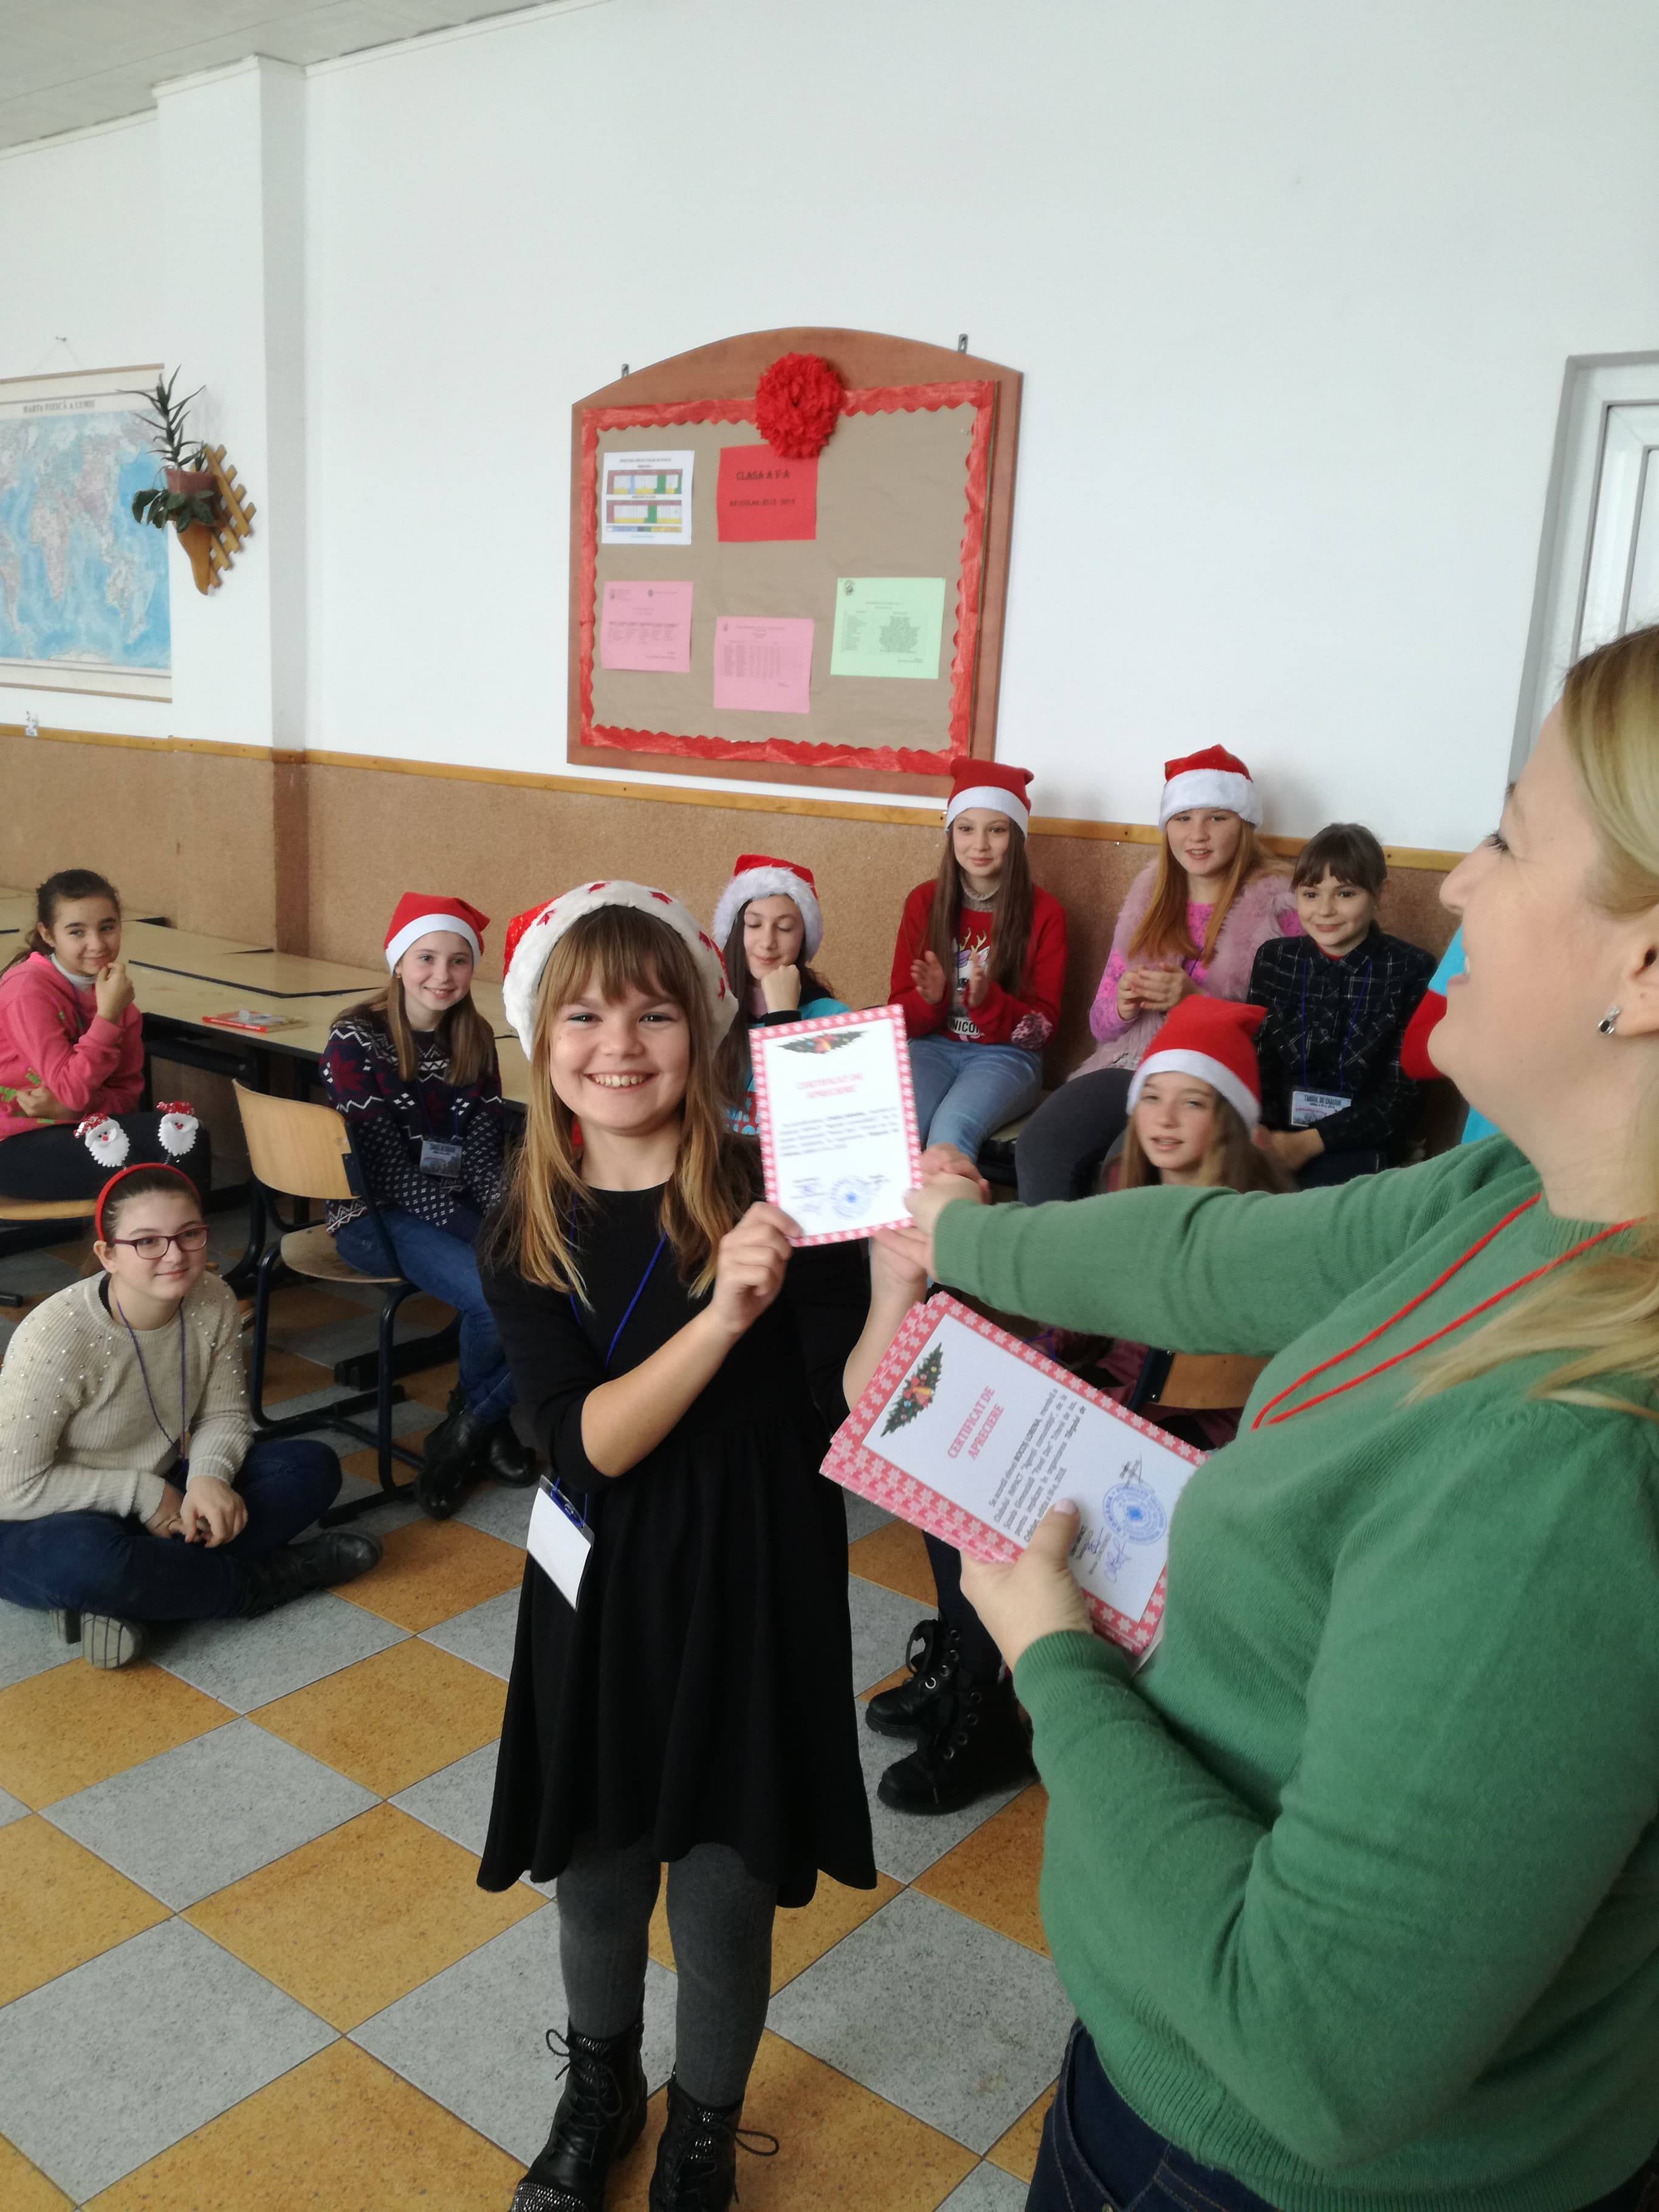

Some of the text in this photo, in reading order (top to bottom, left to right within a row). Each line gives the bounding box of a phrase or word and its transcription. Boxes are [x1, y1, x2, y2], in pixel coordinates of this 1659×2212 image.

[736, 471, 763, 480] CLASA
[946, 1386, 995, 1460] CERTIFICAT DE
[965, 1403, 1005, 1460] APRECIERE
[1006, 1472, 1024, 1497] IMPACT
